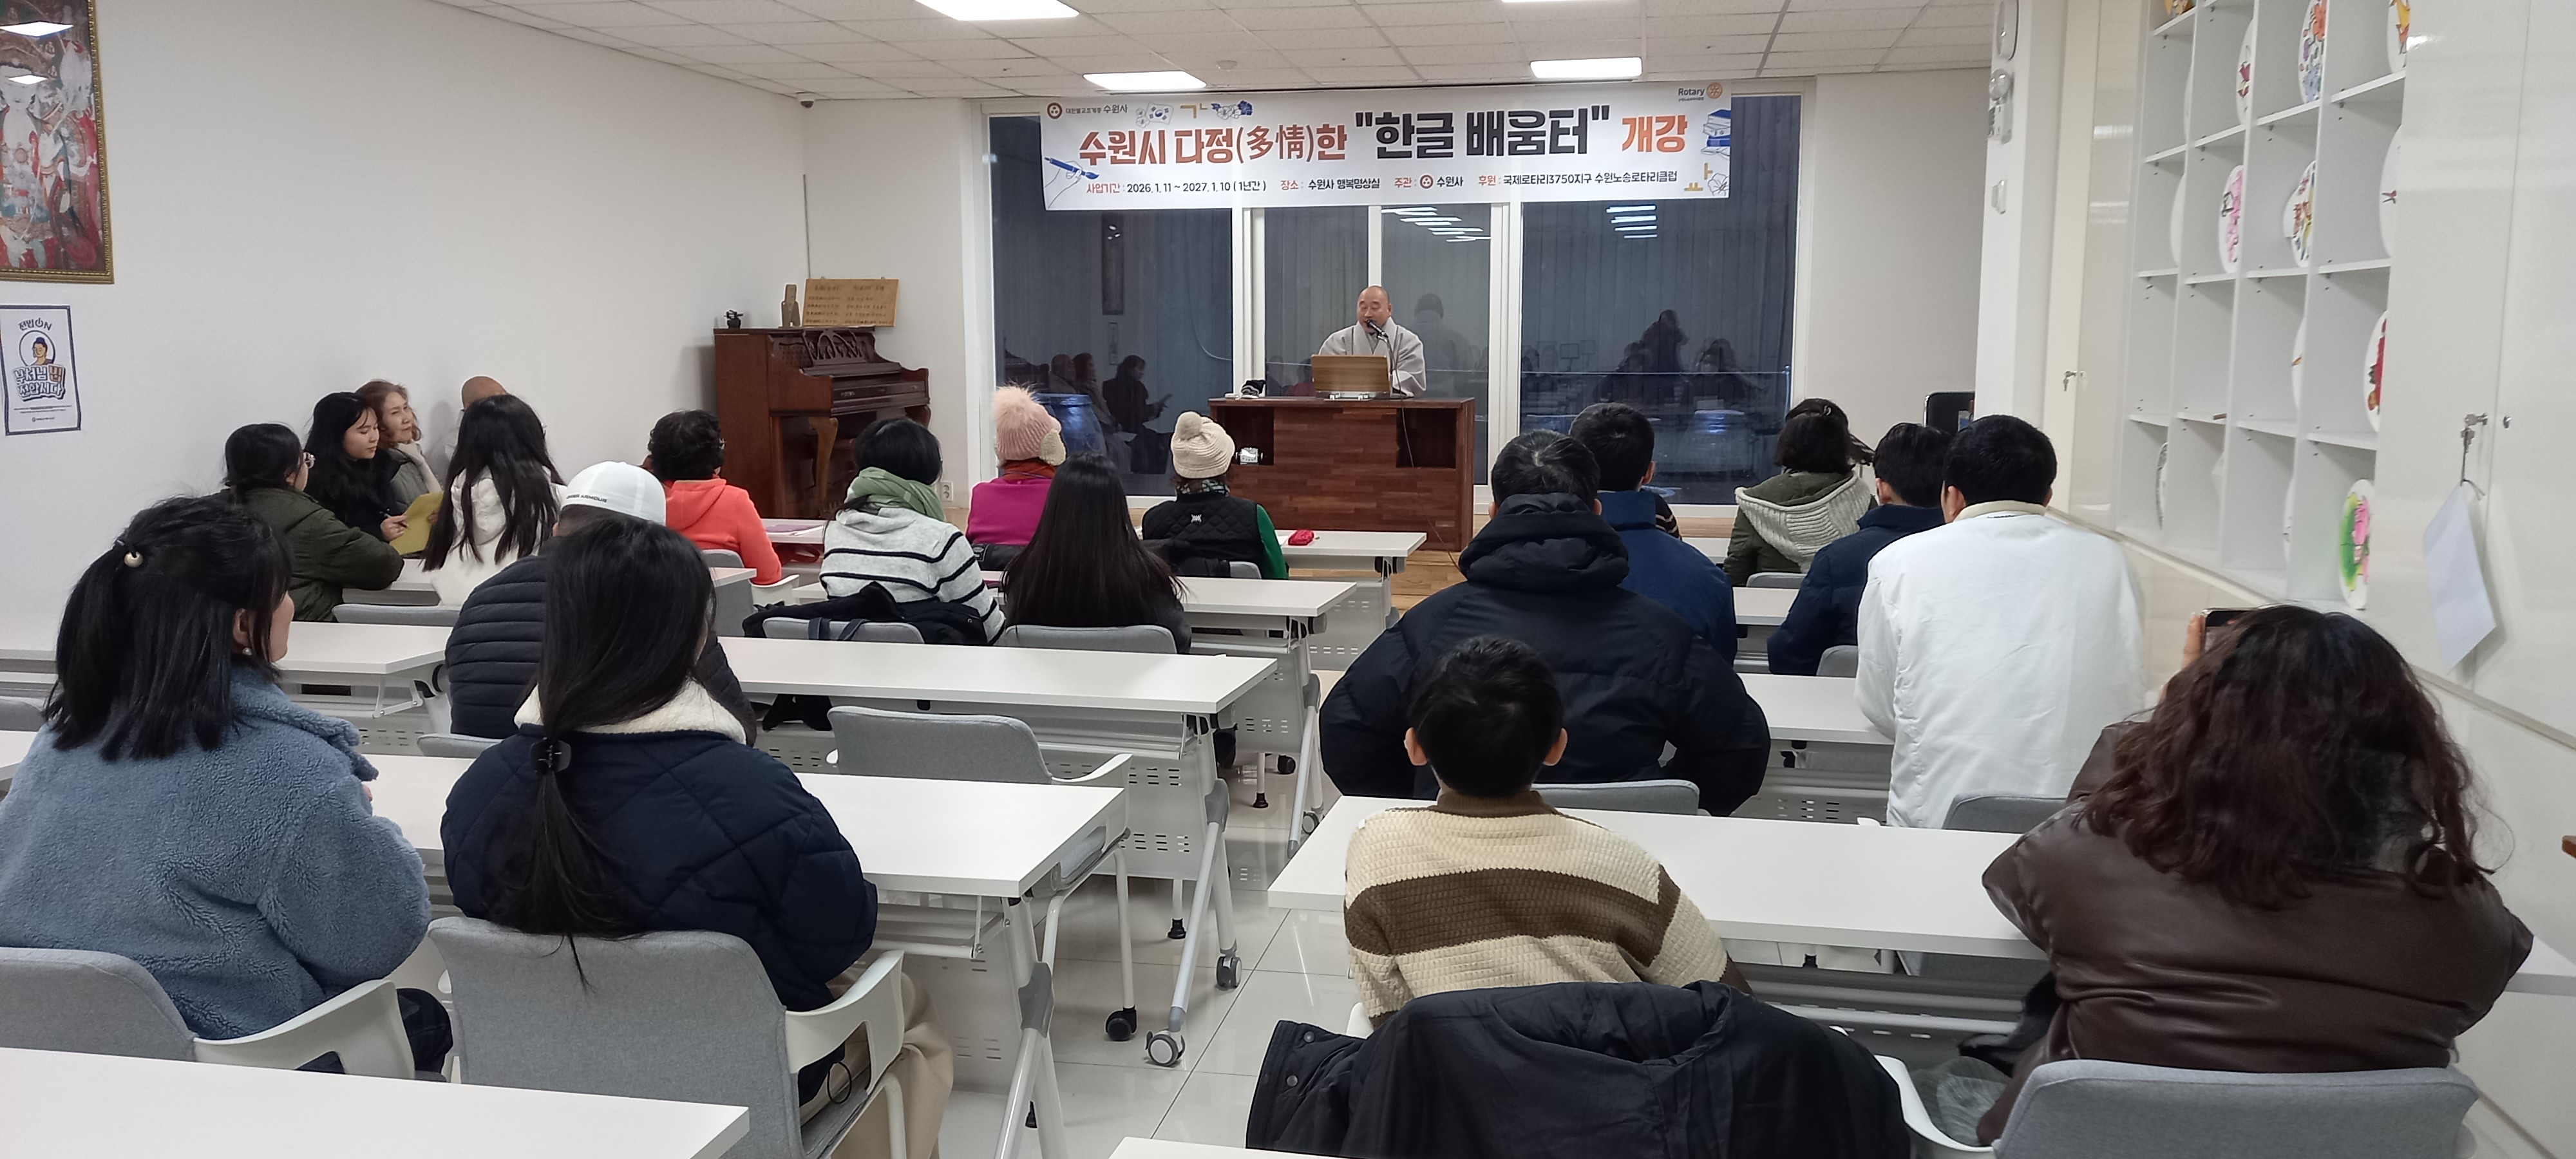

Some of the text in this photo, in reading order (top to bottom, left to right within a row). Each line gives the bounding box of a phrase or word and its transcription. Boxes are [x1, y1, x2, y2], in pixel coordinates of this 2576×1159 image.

[1678, 88, 1705, 96] Rotary
[1103, 104, 1128, 114] 수원사
[1079, 105, 1689, 165] 수원시 다정(多情)한 "한글 배움터" 개강
[1280, 180, 1299, 191] 장소
[1308, 179, 1335, 190] 수원사
[1336, 178, 1381, 189] 행복명상실
[1394, 177, 1412, 188] 주관
[1437, 176, 1464, 187] 수원사
[1478, 175, 1496, 186] 후원
[1503, 173, 1593, 185] 국제로타리3750지구
[1595, 171, 1678, 184] 수원노송로타리클럽
[1086, 183, 1121, 194] 사업기간
[48, 364, 63, 382] 법
[580, 495, 607, 503] ARMOUR
